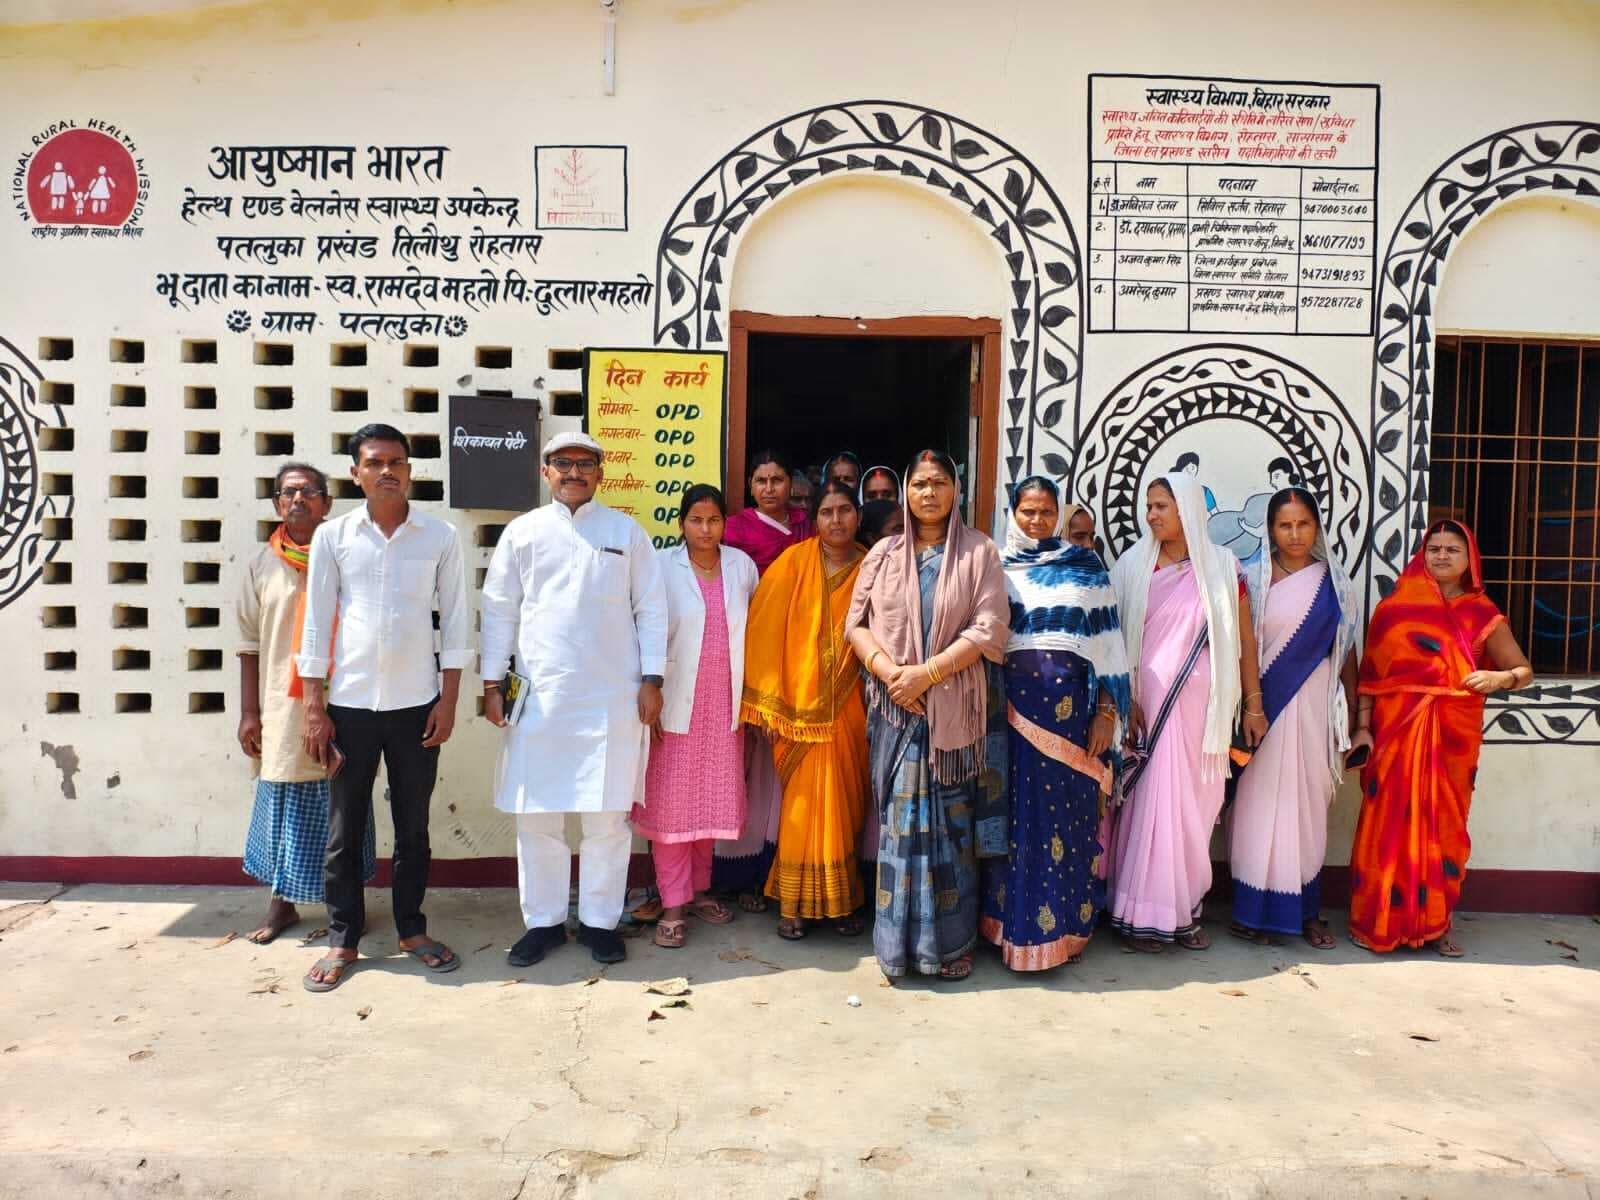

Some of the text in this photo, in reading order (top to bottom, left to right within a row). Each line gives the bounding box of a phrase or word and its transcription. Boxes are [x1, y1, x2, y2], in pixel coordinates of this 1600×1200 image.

[1145, 88, 1206, 106] स्वास्थ्य
[1252, 88, 1284, 111] बिहार
[1285, 94, 1331, 111] सरकार
[13, 118, 150, 226] NATIONAL RURAL HEALTH MISSION
[208, 146, 451, 187] आयुष्मान भारत
[1136, 178, 1159, 189] नाम
[1218, 178, 1258, 192] पदनाम
[181, 188, 232, 225] हेल्थ
[242, 196, 286, 218] एण्ड
[290, 189, 360, 222] वेलनेस
[367, 197, 440, 224] स्वास्थ्य
[444, 187, 522, 228] उपकेन्द्र
[1254, 200, 1288, 216] रोहतास
[216, 236, 306, 265] पतलुका
[317, 229, 379, 263] प्रखंड
[470, 226, 544, 264] रोहतास
[365, 266, 440, 311] रामदेव
[441, 269, 500, 312] महतो
[339, 313, 444, 340] पतलुका
[664, 362, 710, 389] कार्य
[656, 403, 700, 420] OPD
[453, 426, 527, 455] शिकायत पेटी
[655, 429, 695, 445] OPD
[655, 453, 694, 467] OPD
